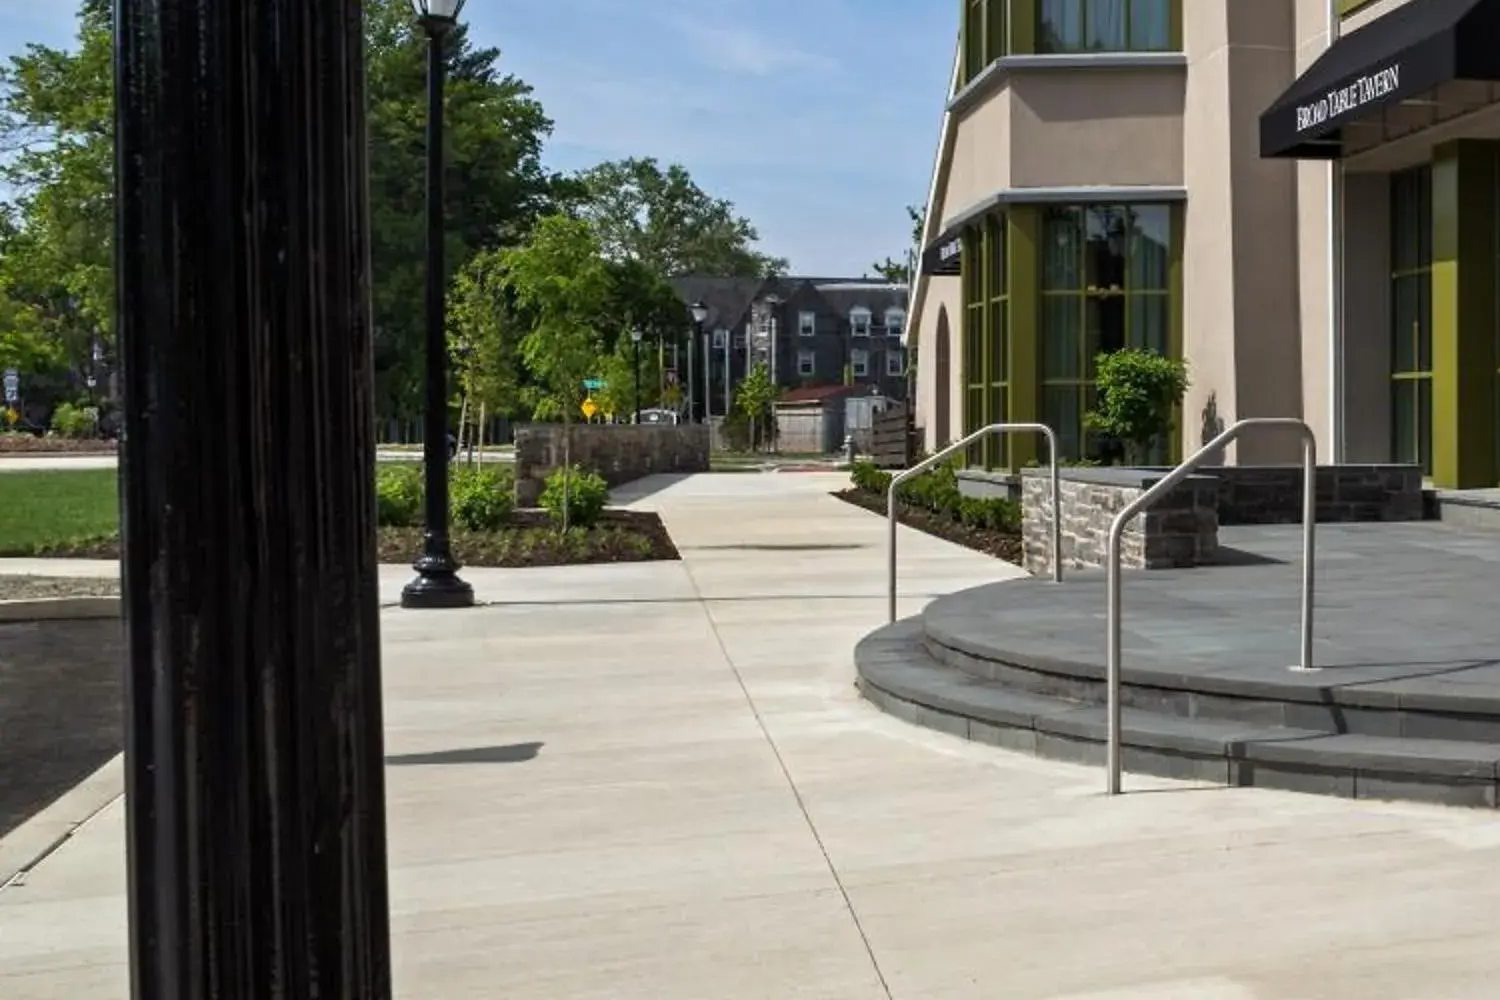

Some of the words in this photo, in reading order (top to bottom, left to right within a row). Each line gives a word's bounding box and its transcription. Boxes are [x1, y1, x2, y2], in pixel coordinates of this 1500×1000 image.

[1296, 99, 1328, 132] BROAD
[1327, 84, 1358, 118] TABLE
[1356, 63, 1400, 105] TAVERN
